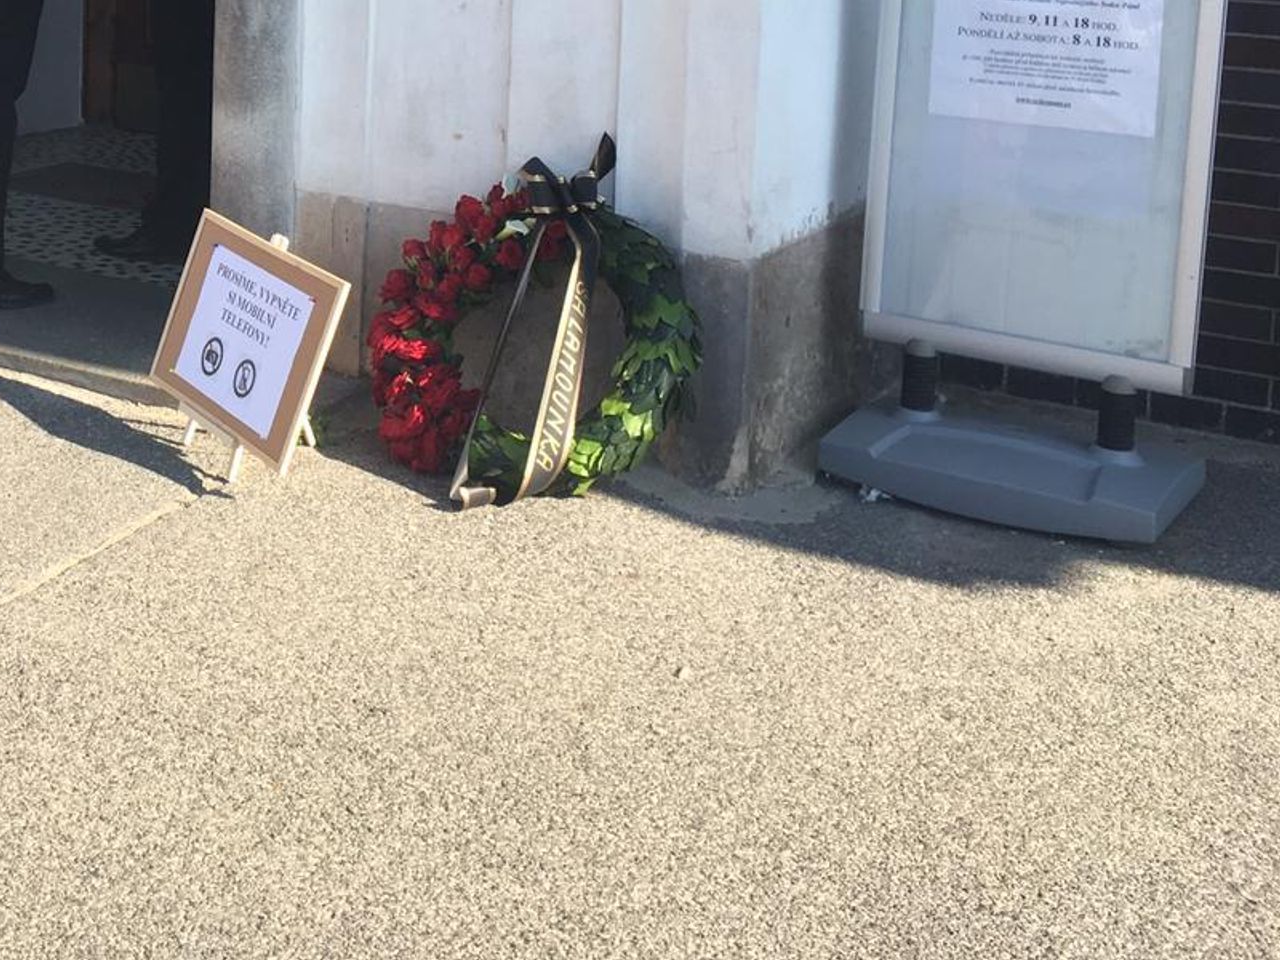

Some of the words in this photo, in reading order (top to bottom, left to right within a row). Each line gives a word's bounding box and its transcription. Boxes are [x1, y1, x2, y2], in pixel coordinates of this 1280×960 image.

[1044, 14, 1059, 27] 11
[1073, 16, 1090, 29] 18
[1072, 34, 1082, 46] 8
[1095, 36, 1111, 48] 18
[226, 290, 237, 306] SI
